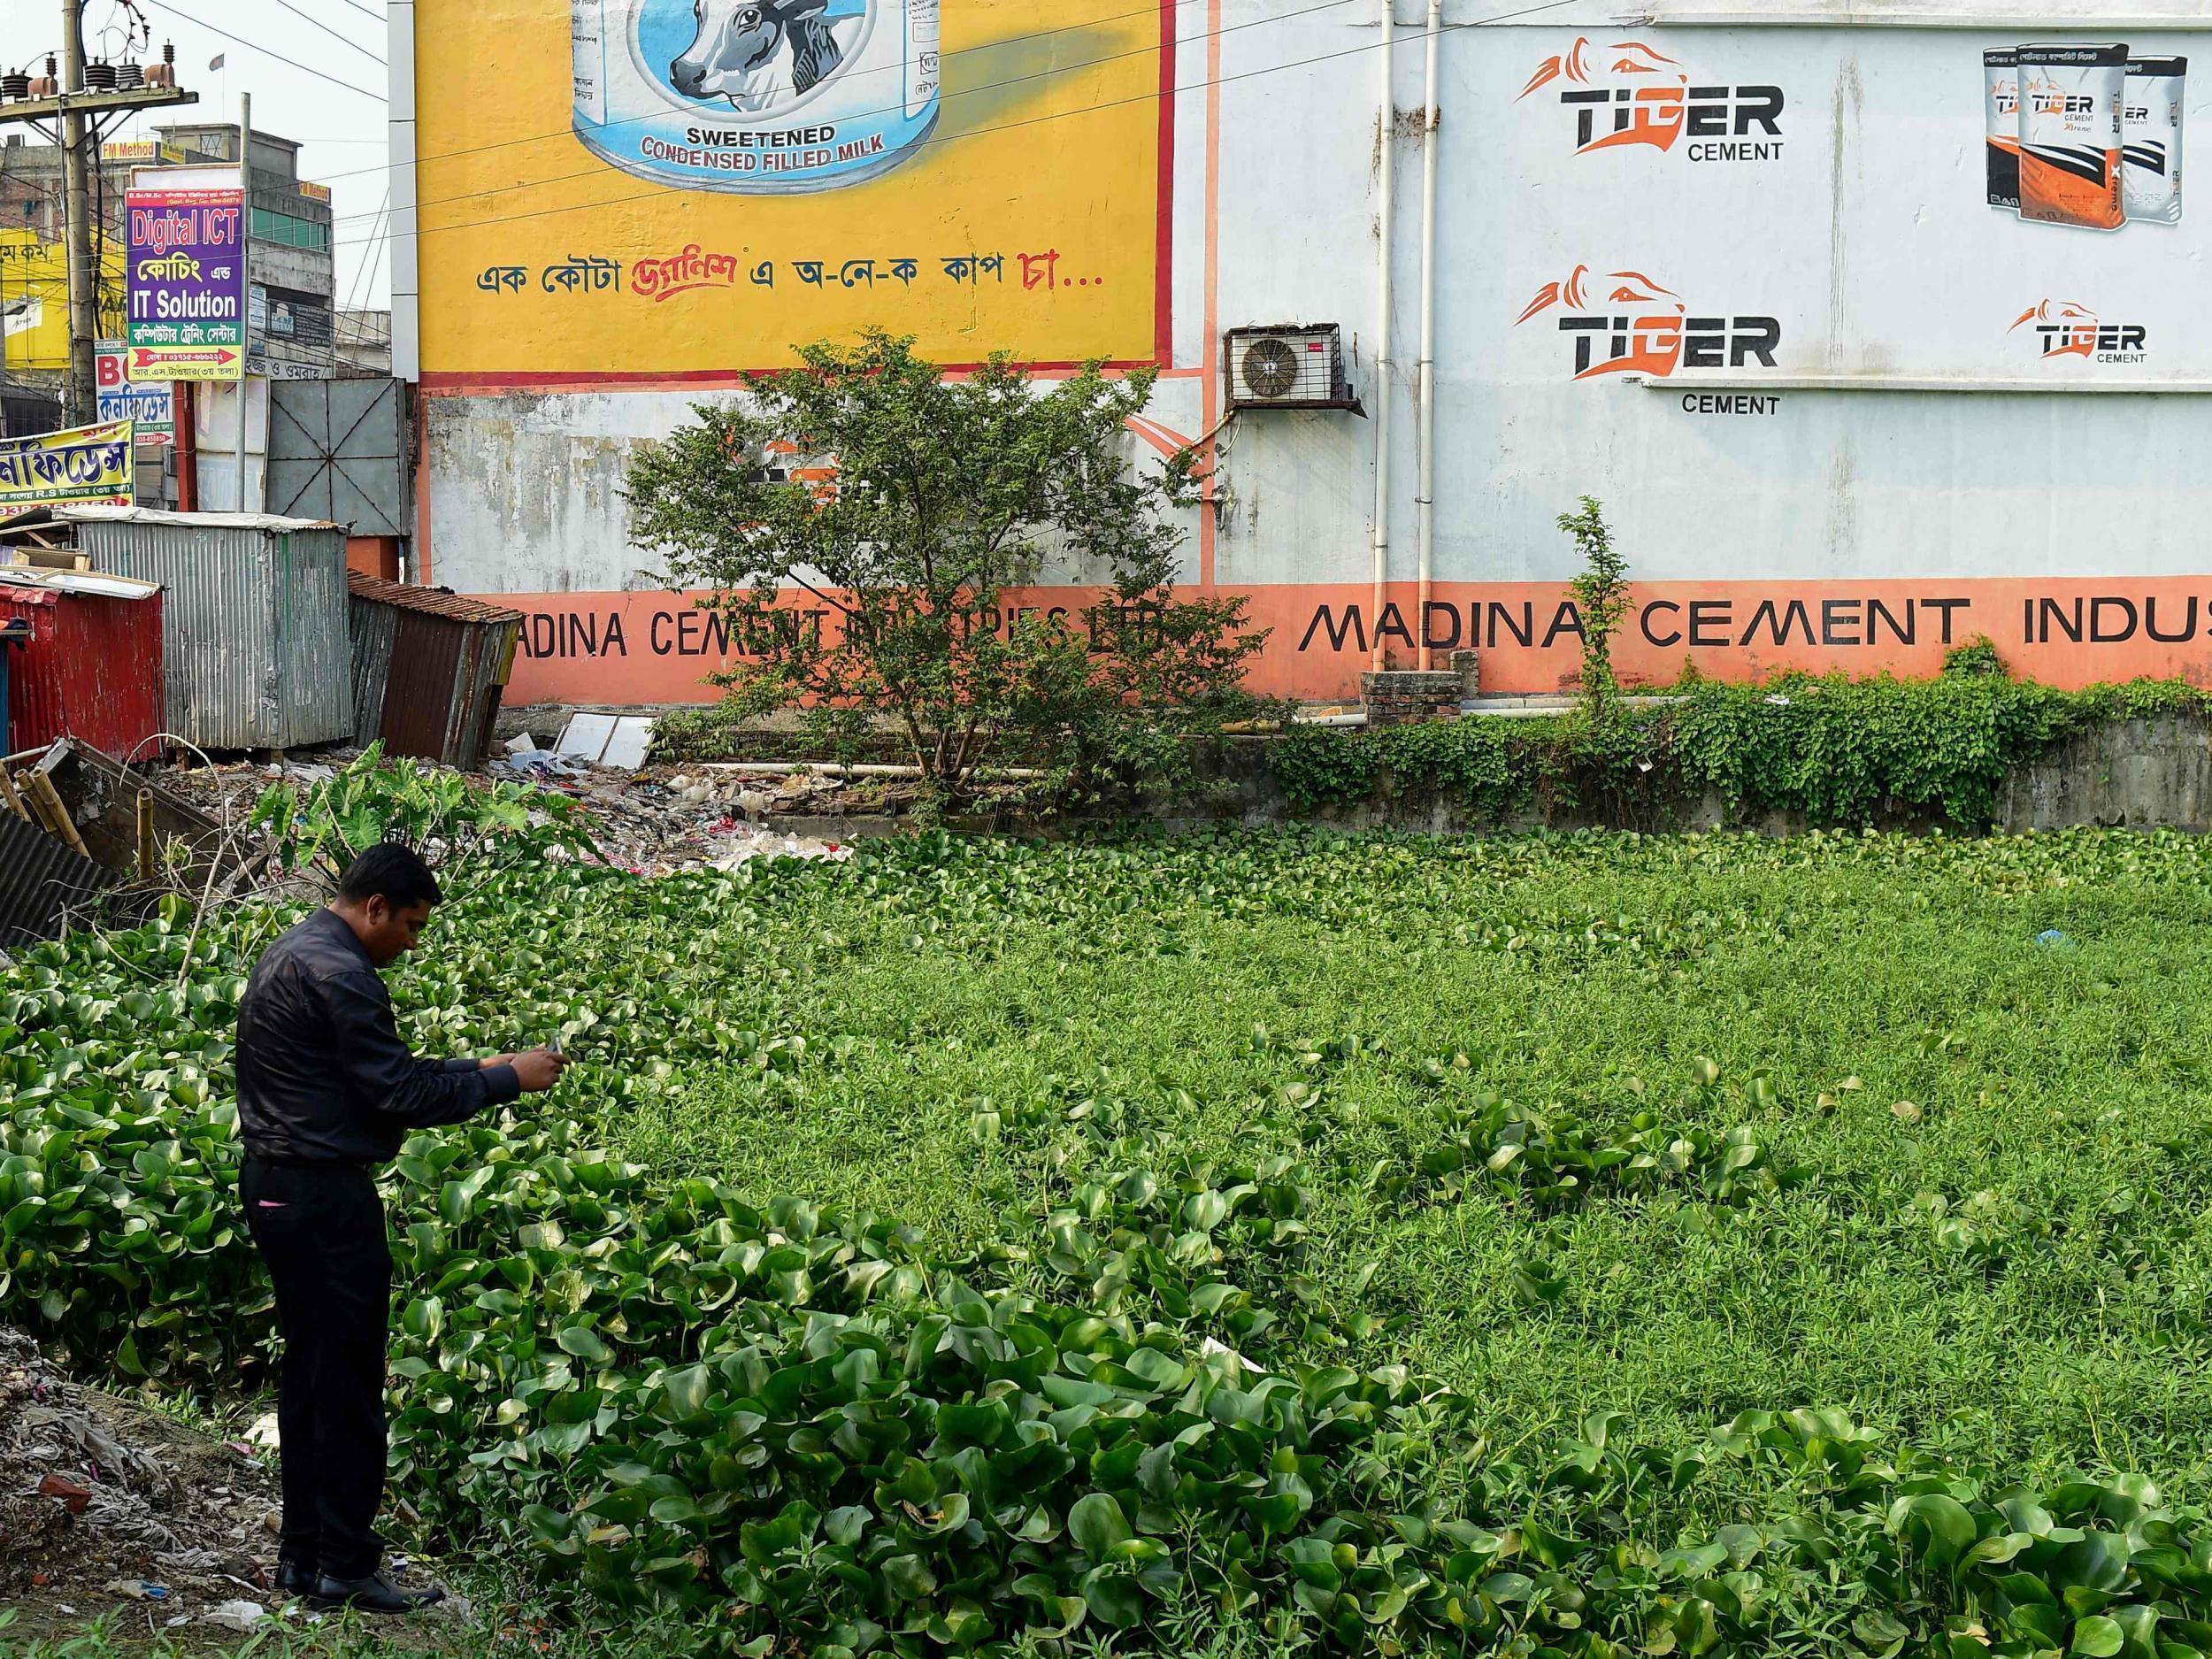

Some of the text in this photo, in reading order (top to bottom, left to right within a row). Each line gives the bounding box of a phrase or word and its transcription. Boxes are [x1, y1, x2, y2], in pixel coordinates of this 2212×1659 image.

[1560, 86, 1785, 154] TIGER
[2032, 95, 2093, 114] TIGER
[103, 143, 116, 157] FM
[119, 142, 154, 157] Method
[641, 134, 885, 171] CONDENSED FILLED MILK
[687, 126, 835, 148] SWEETENED
[1687, 142, 1785, 162] CEMENT
[132, 209, 239, 255] Digital ICT
[137, 251, 203, 282] কোচিং
[476, 265, 528, 295] এক
[541, 253, 623, 294] কৌটা
[630, 243, 738, 298] ড্যানিশ
[749, 260, 774, 289] এ
[940, 250, 1005, 285] কাপ
[134, 289, 151, 319] IT
[156, 288, 235, 319] Solution
[133, 322, 236, 344] কম্পিউটার ট্রেনিং সেন্টার
[1559, 316, 1781, 380] TIGER
[2036, 325, 2147, 358] TIGER
[2097, 353, 2147, 364] CEMENT
[1682, 393, 1780, 416] CEMENT
[36, 488, 57, 498] R.S
[516, 611, 627, 658] ADINA
[1297, 595, 2212, 653] MADINA CEMENT INDU
